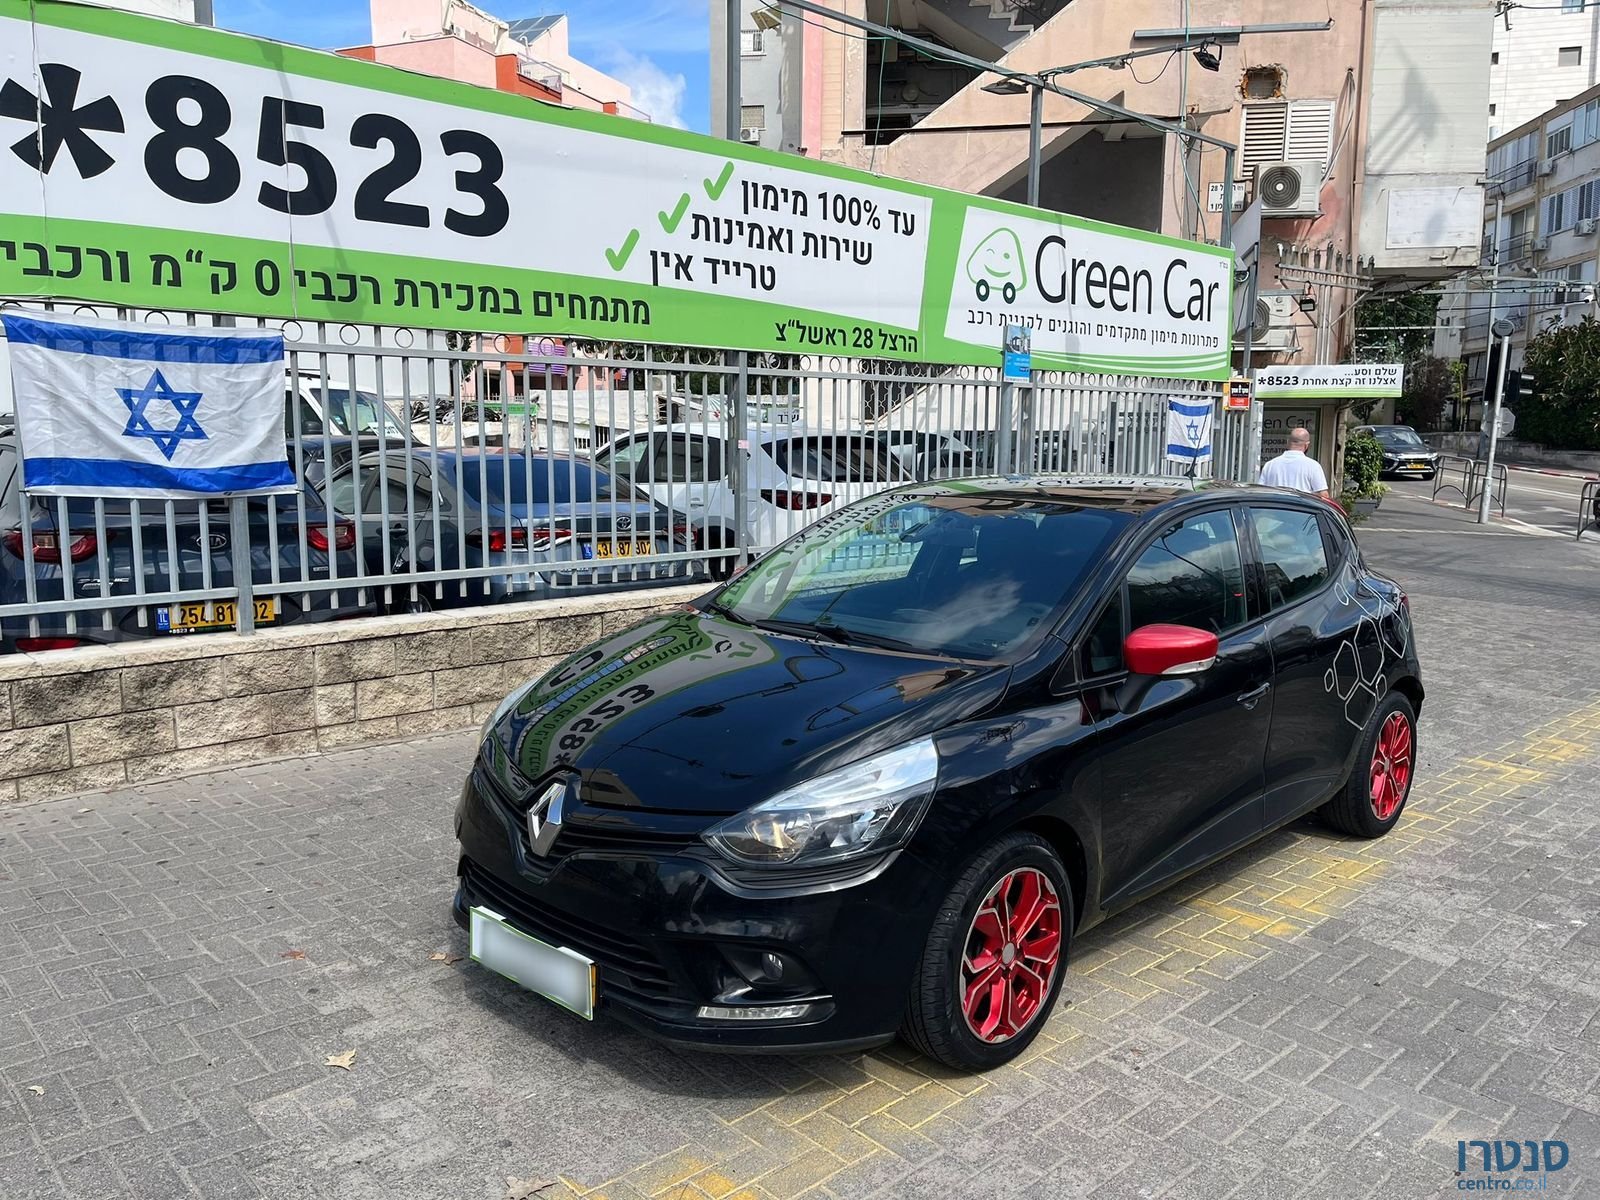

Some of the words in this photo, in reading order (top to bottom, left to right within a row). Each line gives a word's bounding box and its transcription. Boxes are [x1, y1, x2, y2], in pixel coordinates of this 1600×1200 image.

[741, 180, 808, 217] מימון
[818, 191, 882, 231] 100%
[690, 213, 793, 254] ואמינות
[888, 209, 916, 237] עד
[802, 231, 872, 266] שירות
[254, 259, 281, 297] 0
[649, 250, 694, 287] אין
[704, 257, 777, 291] טרייד
[1035, 235, 1152, 315] Green
[1163, 258, 1219, 322] Car
[294, 269, 381, 305] רכבי
[394, 278, 523, 315] במכירת
[532, 290, 650, 326] מתמחים
[967, 309, 993, 326] רכב
[775, 319, 847, 347] ראשל"צ
[998, 312, 1043, 331] לקניית
[1048, 318, 1091, 336] והוגנים
[1096, 323, 1147, 343] מתקדמים
[852, 326, 874, 349] 28
[878, 328, 918, 353] הרצל
[1151, 329, 1177, 346] מימון
[1180, 333, 1219, 348] פתרונות
[1301, 377, 1329, 386] אחרת
[1331, 377, 1352, 388] קצת
[1355, 376, 1366, 385] זה
[1368, 376, 1397, 386] אצלנו
[1374, 366, 1397, 376] שלם
